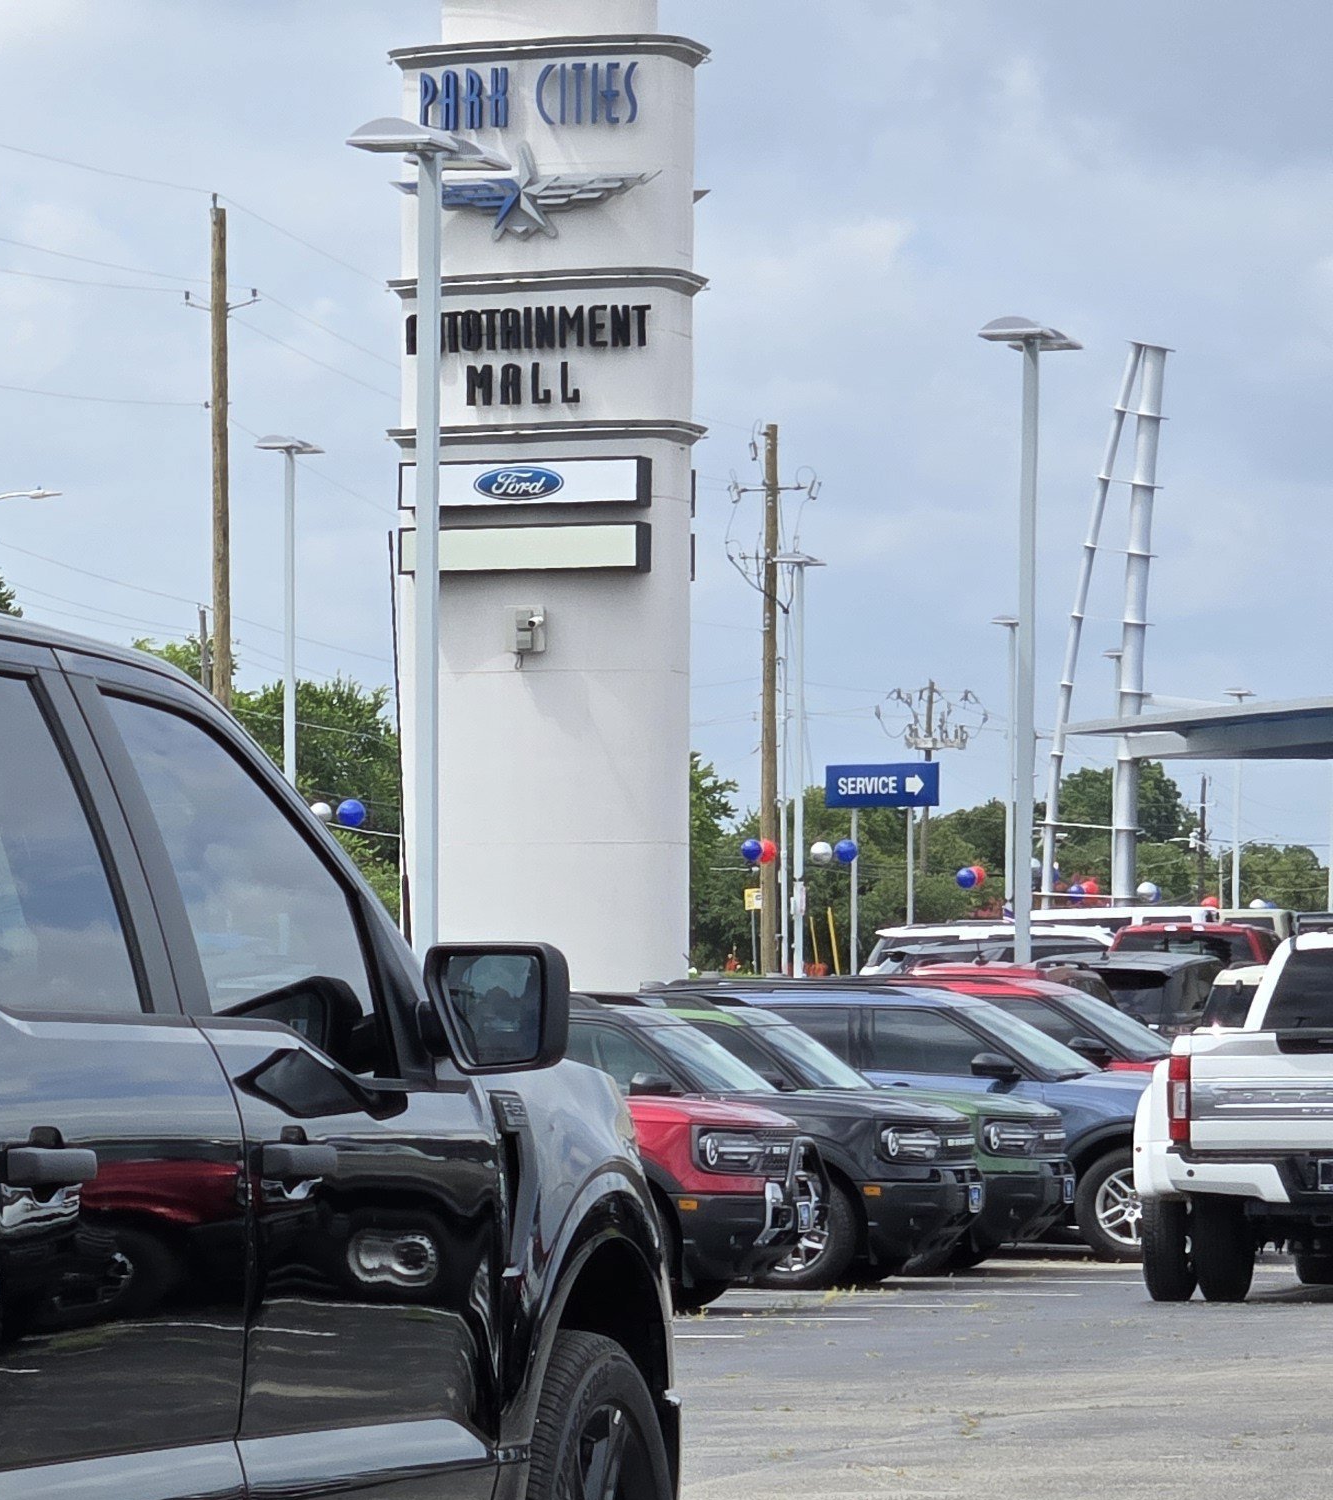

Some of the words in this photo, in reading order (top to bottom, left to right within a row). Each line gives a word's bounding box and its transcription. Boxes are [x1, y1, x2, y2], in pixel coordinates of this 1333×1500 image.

[420, 66, 509, 131] PARK
[536, 61, 639, 125] CITIES
[406, 304, 652, 355] TOTAINMENT
[466, 361, 581, 406] MALL
[491, 471, 547, 494] Ford
[837, 776, 898, 796] SERVICE
